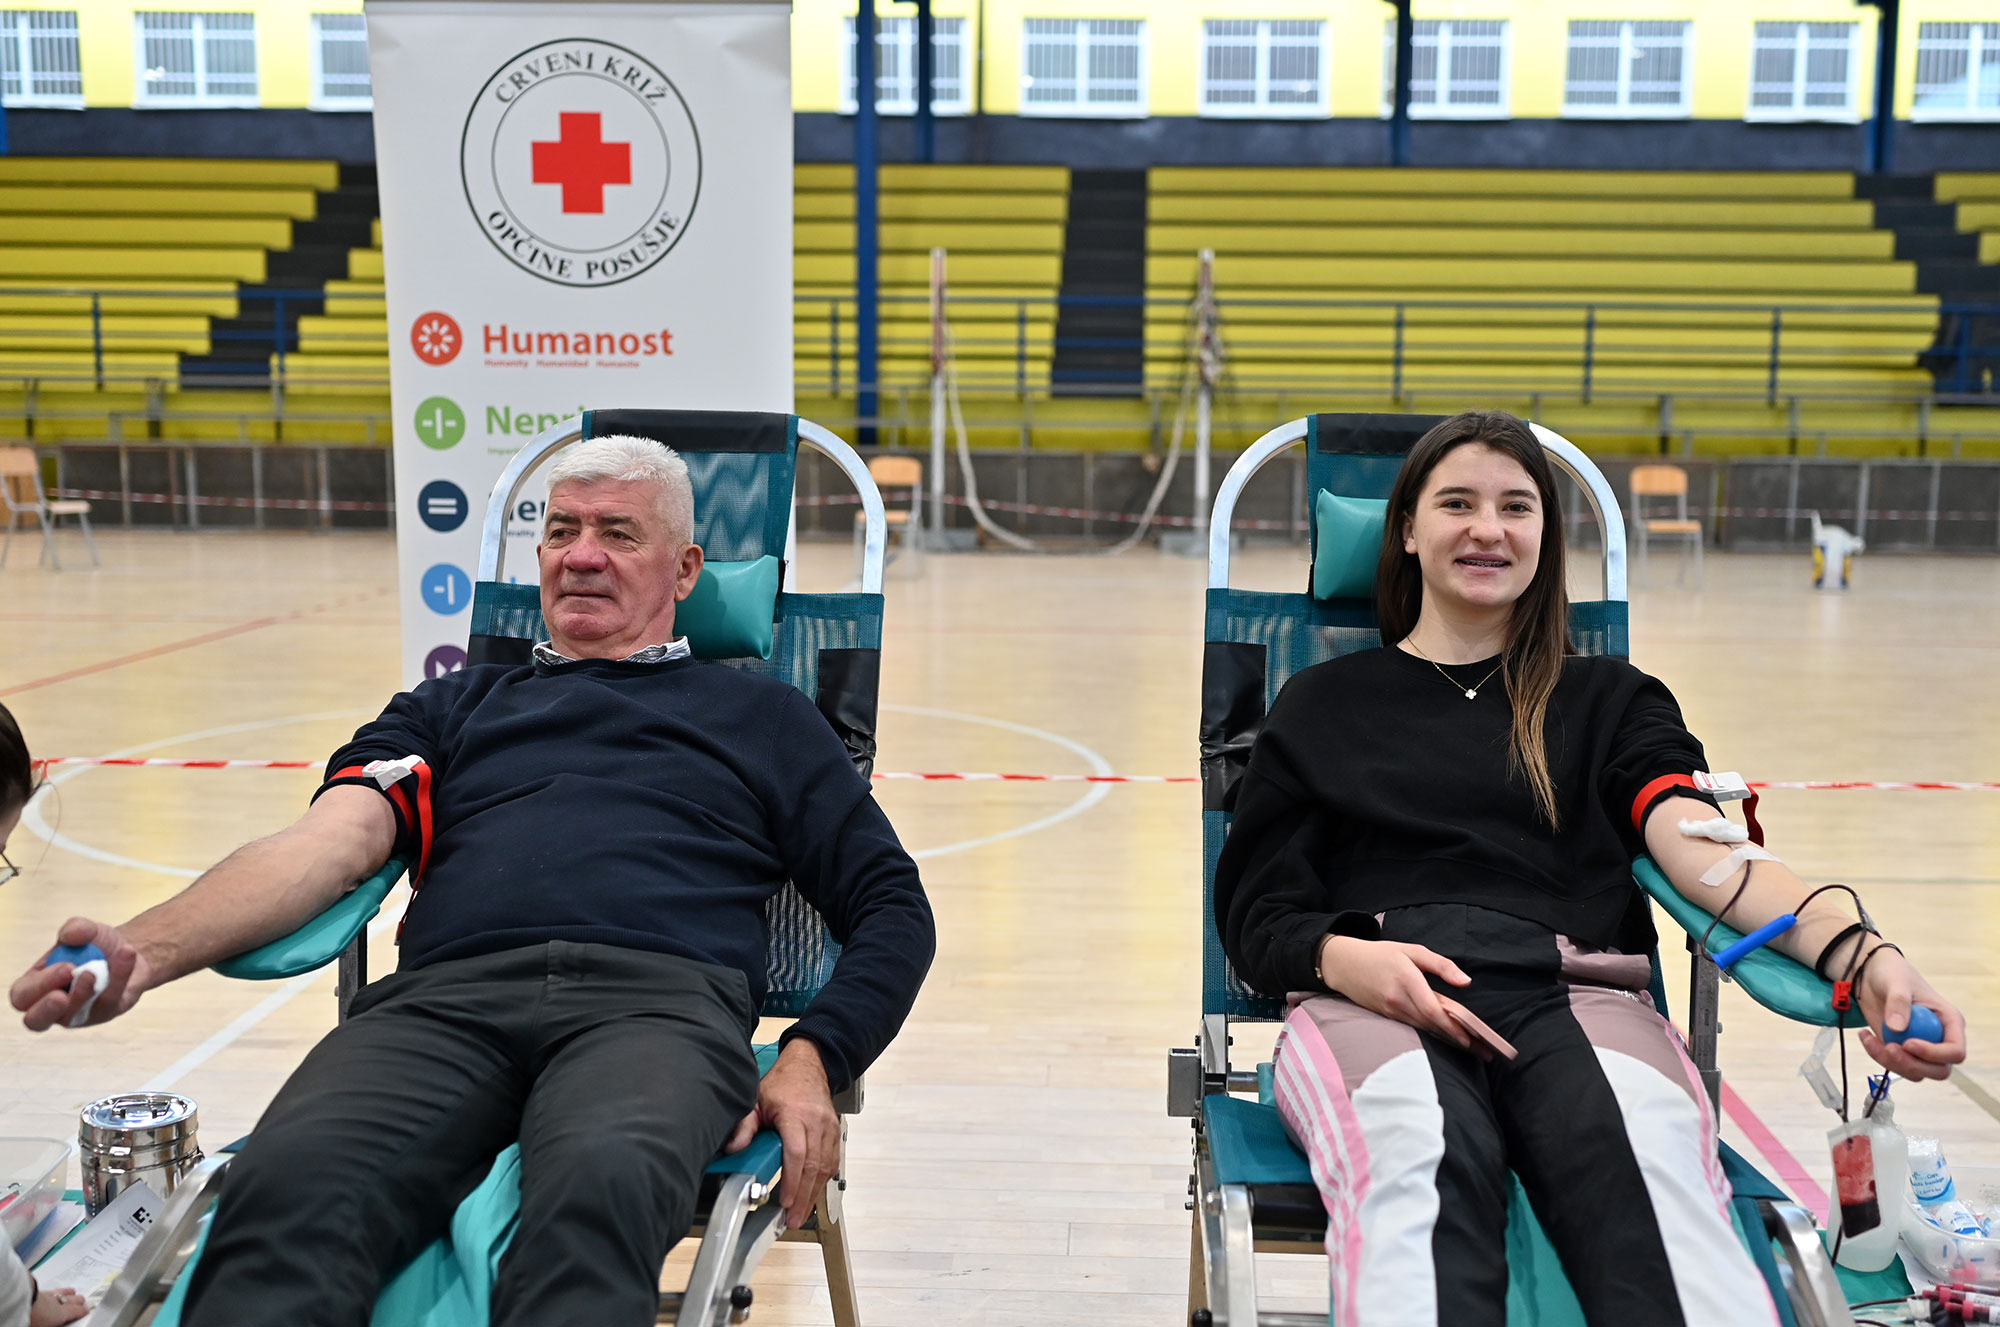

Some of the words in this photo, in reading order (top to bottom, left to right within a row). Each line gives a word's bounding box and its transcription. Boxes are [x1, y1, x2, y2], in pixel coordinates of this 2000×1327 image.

[494, 50, 594, 104] CRVENI
[603, 55, 668, 107] KRIŽ
[585, 210, 681, 280] POSUŠJE
[482, 324, 674, 356] Humanost
